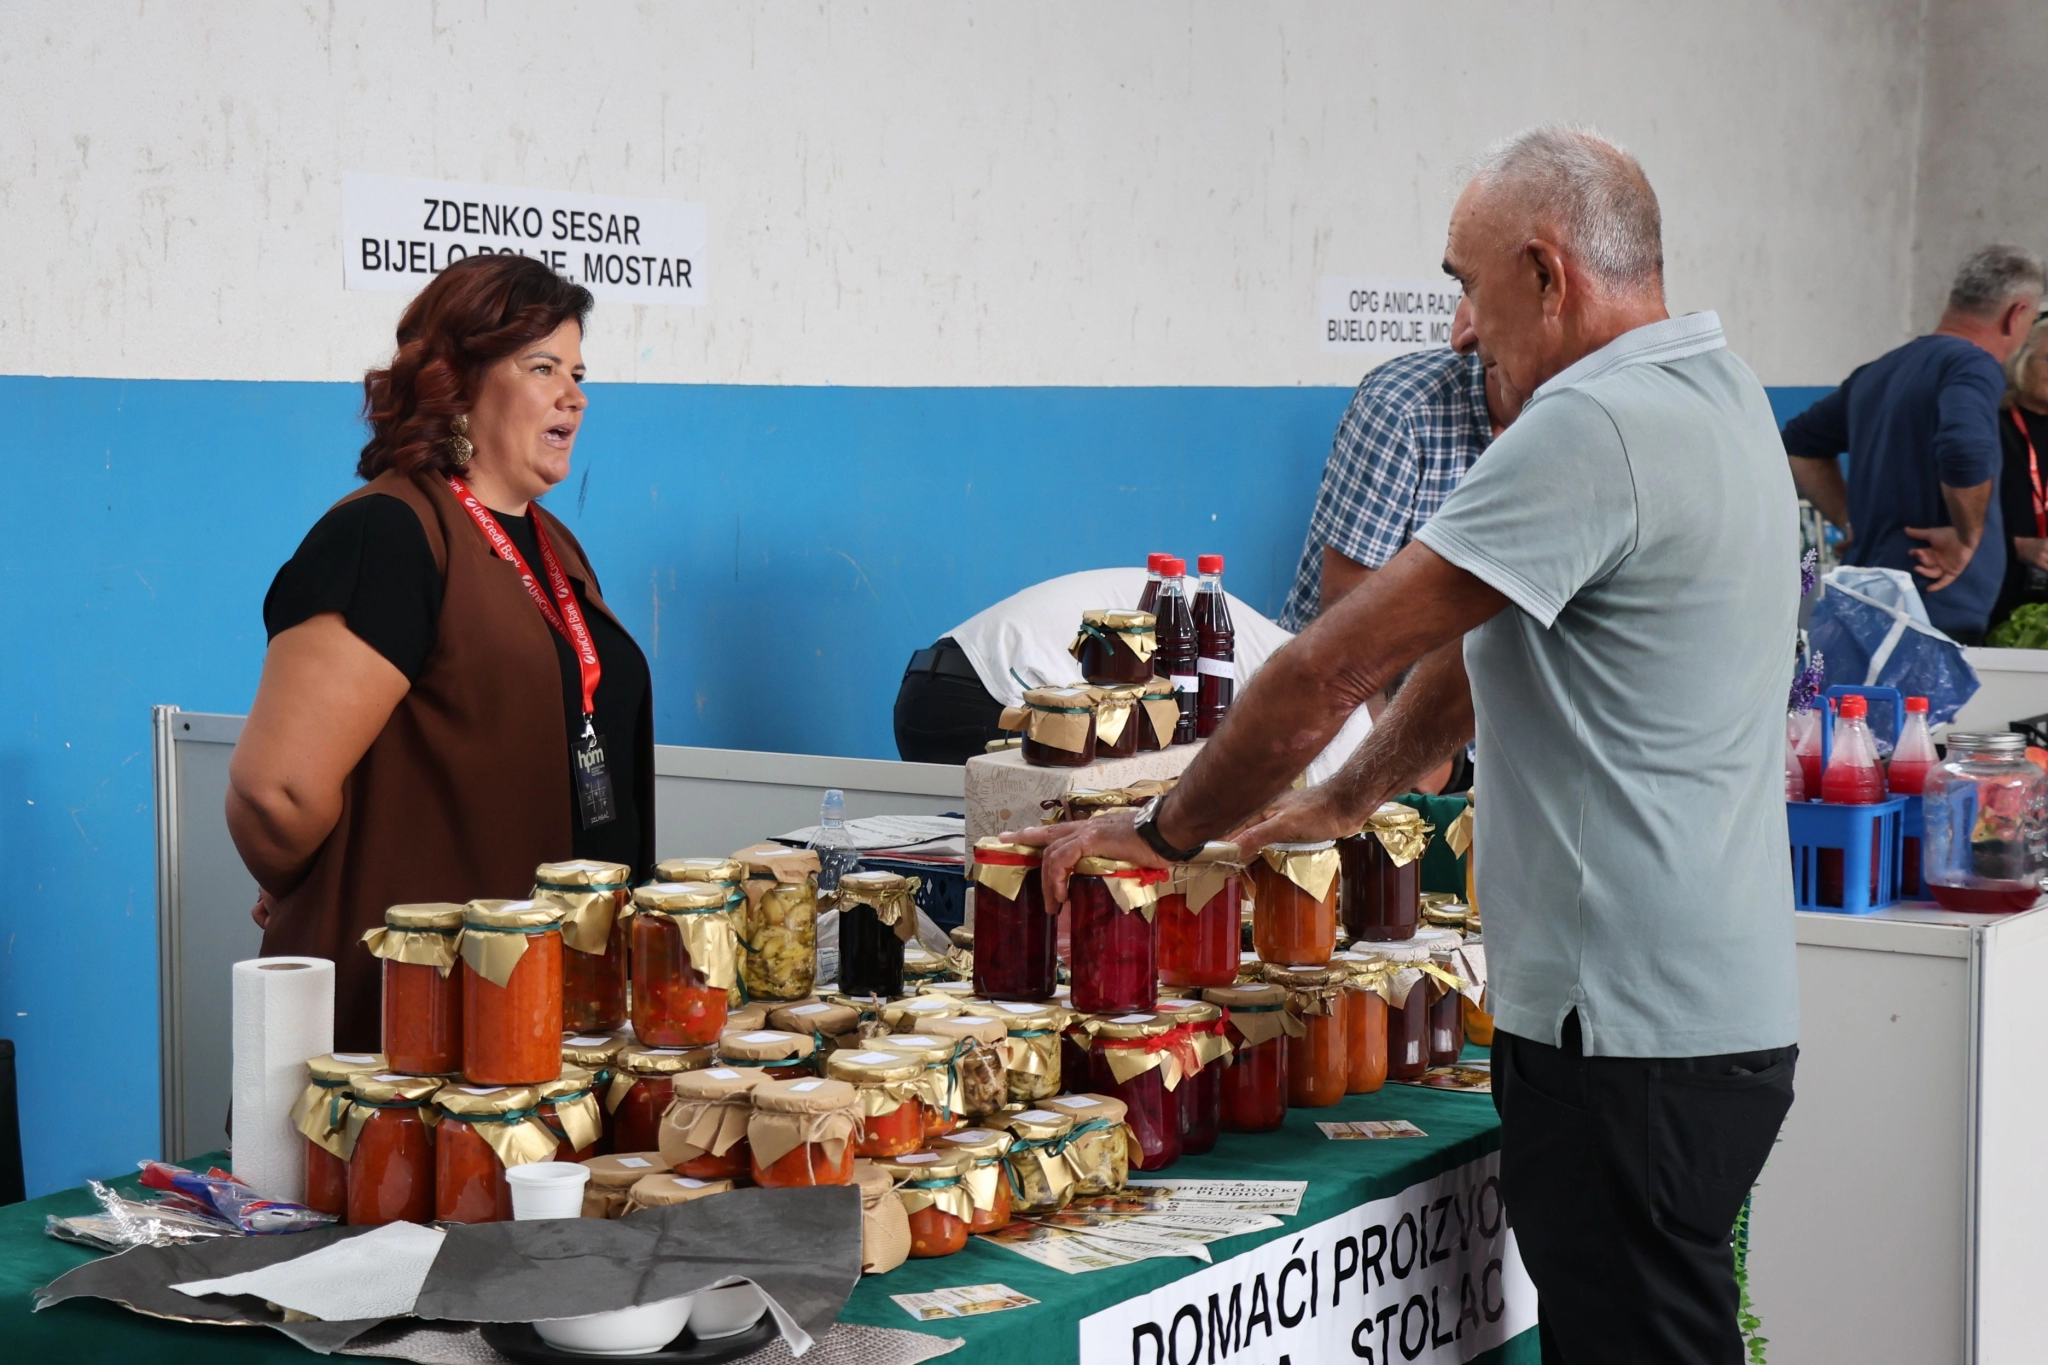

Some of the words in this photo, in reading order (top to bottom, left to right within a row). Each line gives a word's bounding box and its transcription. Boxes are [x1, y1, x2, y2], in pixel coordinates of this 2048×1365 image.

[423, 198, 543, 238] ZDENKO
[552, 209, 641, 246] SESAR
[584, 253, 692, 288] MOSTAR
[1349, 290, 1379, 313] OPG
[1383, 291, 1425, 315] ANICA
[1327, 319, 1377, 342] BIJELO
[1381, 320, 1427, 347] POLJE,
[1430, 322, 1454, 343] MO
[447, 476, 464, 494] ank
[472, 506, 507, 547] UniCredit
[543, 548, 566, 591] UniCredit
[528, 584, 560, 628] UniCredit
[564, 602, 581, 624] Bank
[570, 622, 593, 655] UniCredit
[578, 747, 605, 773] hpm
[1177, 1185, 1298, 1193] HERCEGOVAČKI
[1132, 1238, 1319, 1365] DOMAĆI
[1332, 1175, 1513, 1307] PROIZVO
[1352, 1258, 1506, 1365] STOLAC
